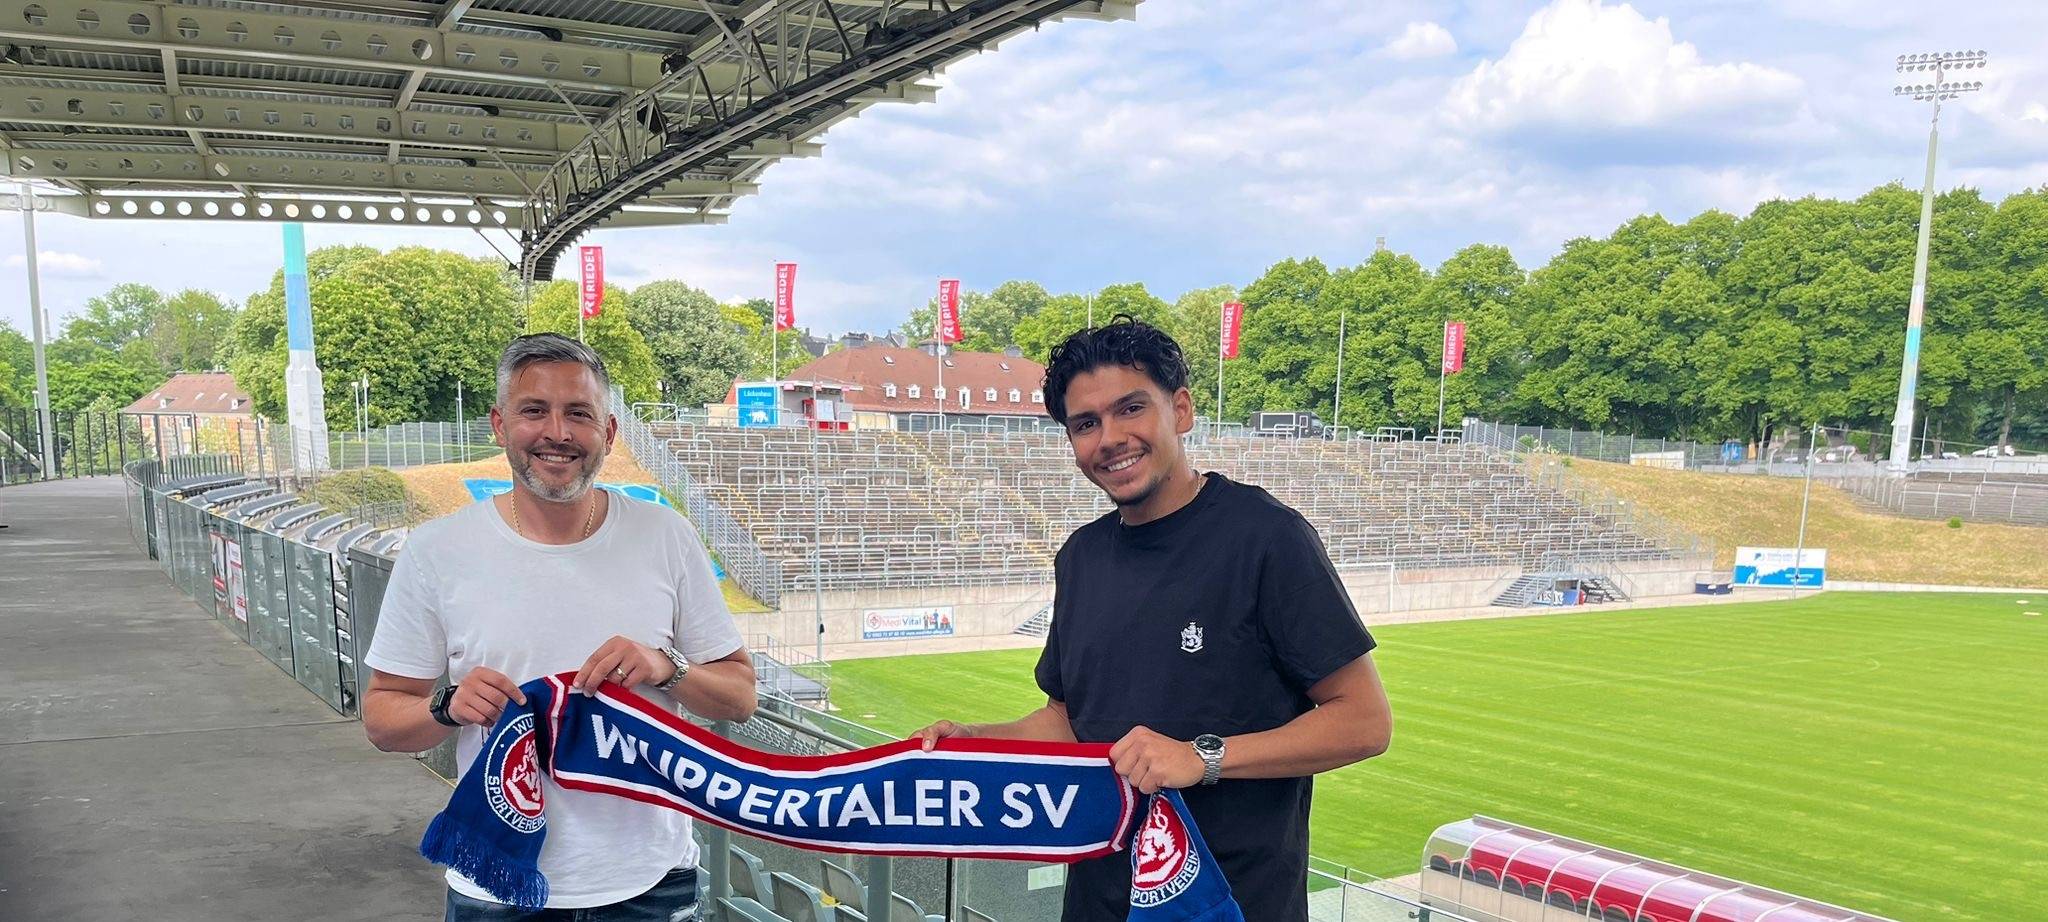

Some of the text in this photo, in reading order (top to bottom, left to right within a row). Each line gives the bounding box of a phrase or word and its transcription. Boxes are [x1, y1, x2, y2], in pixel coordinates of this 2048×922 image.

[584, 248, 596, 293] RIEDEL
[779, 265, 788, 306] RIEDEL
[941, 281, 953, 319] RIEDEL
[1223, 305, 1235, 338] RIEDEL
[1447, 325, 1457, 355] RIEDEL
[590, 713, 1080, 828] WUPPERTALER SV
